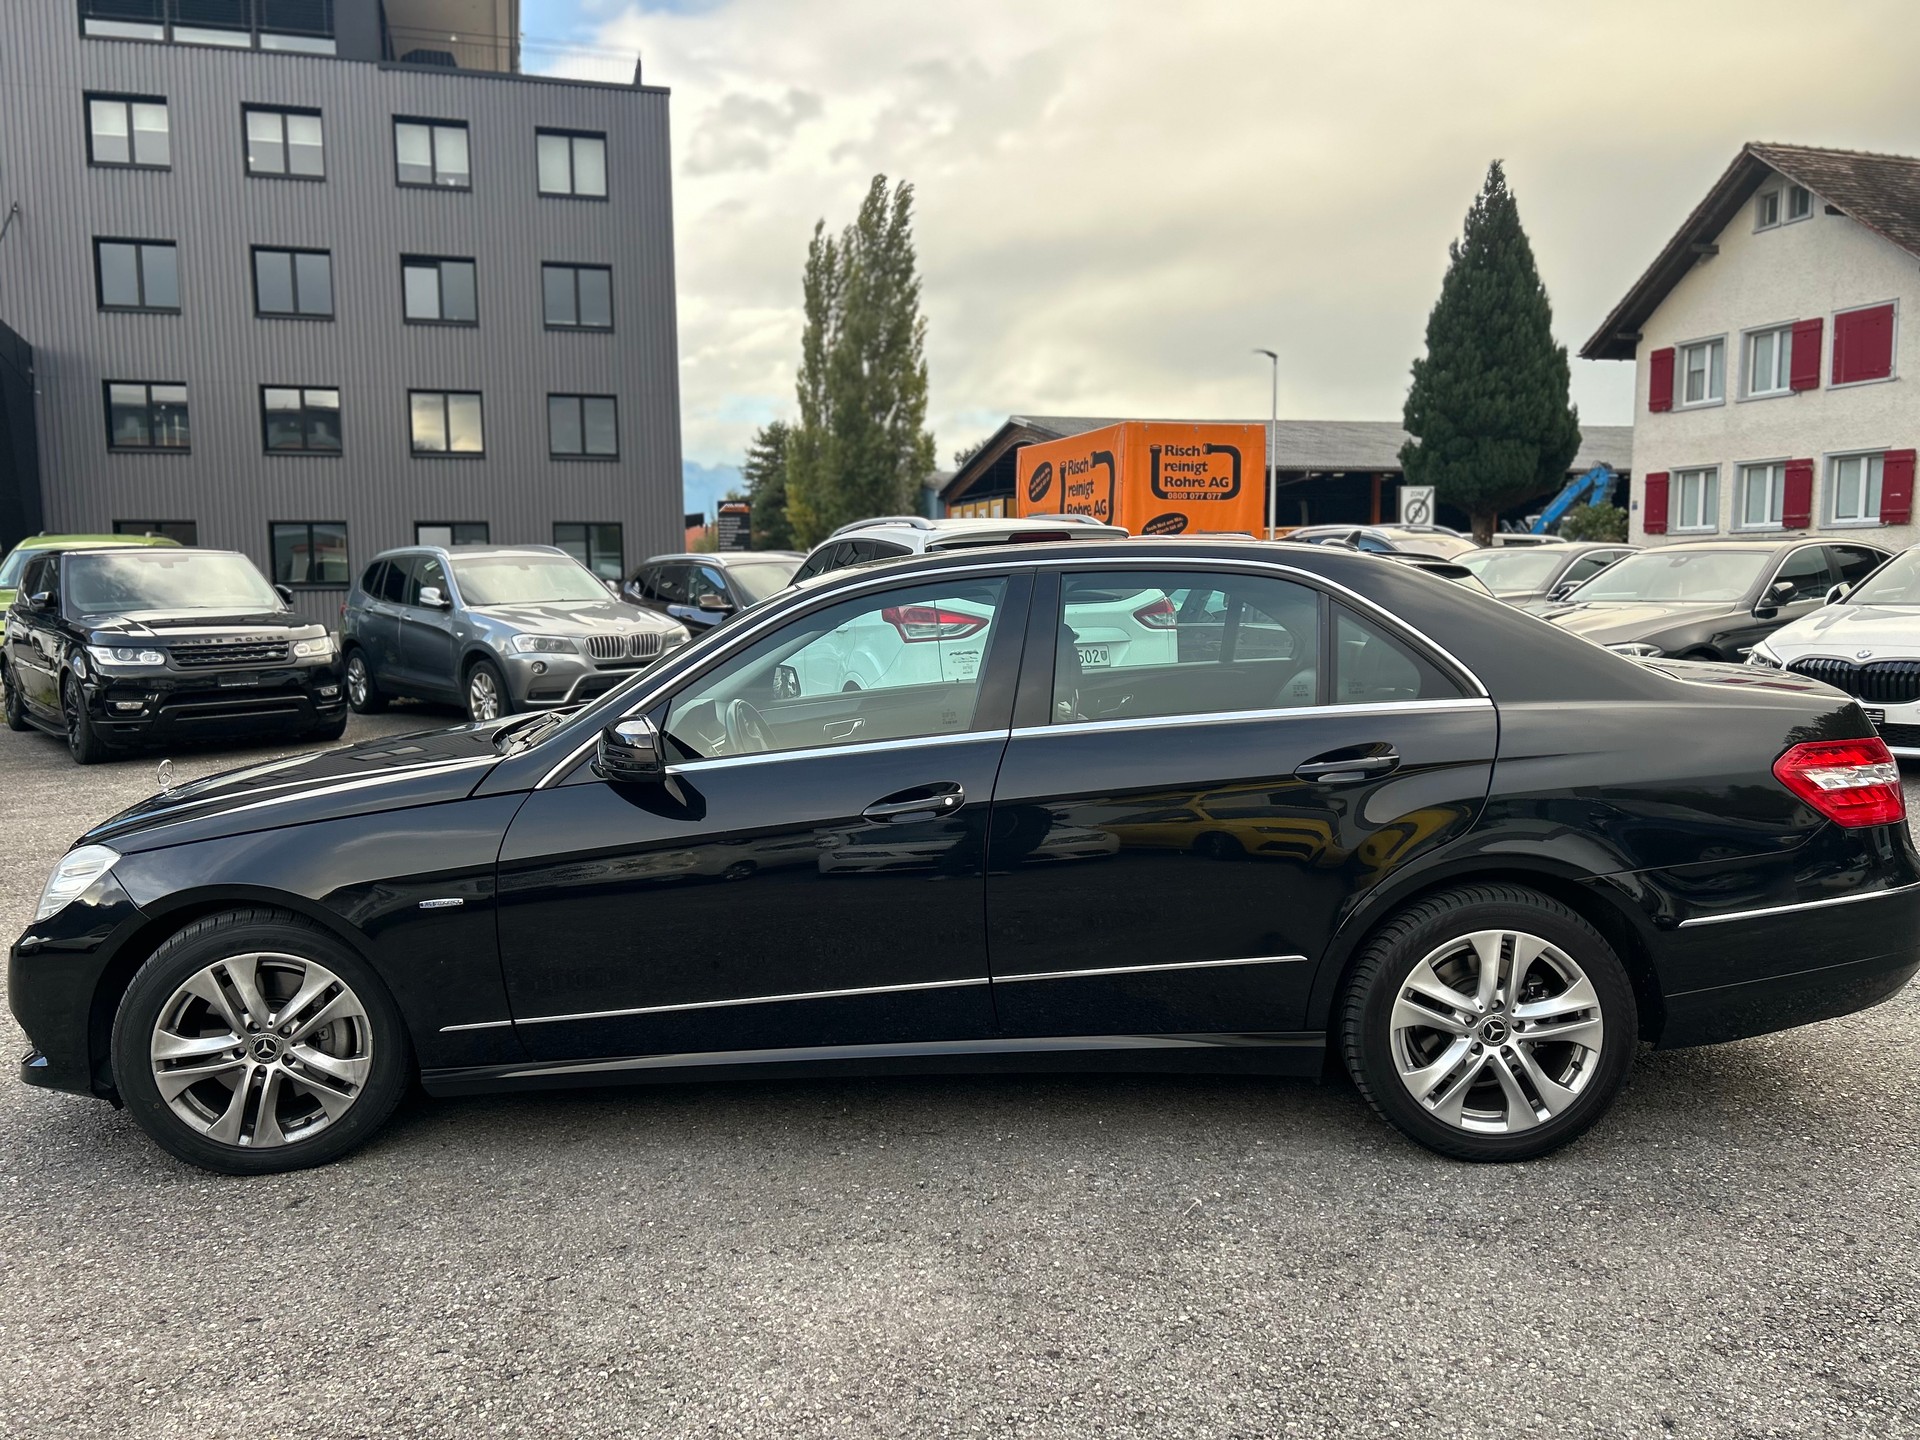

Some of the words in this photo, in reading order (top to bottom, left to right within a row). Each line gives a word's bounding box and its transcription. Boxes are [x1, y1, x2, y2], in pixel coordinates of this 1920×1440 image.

[1164, 444, 1201, 457] Risch
[1067, 457, 1089, 476] Risch
[1164, 460, 1209, 476] reinigt
[1067, 478, 1095, 500] reinigt
[1164, 476, 1206, 488] Rohre
[1208, 476, 1229, 488] AG
[1167, 492, 1188, 500] 0800
[1189, 492, 1204, 500] 077
[1206, 492, 1222, 500] 077
[1067, 502, 1092, 516] Rohre
[1093, 498, 1107, 516] AG
